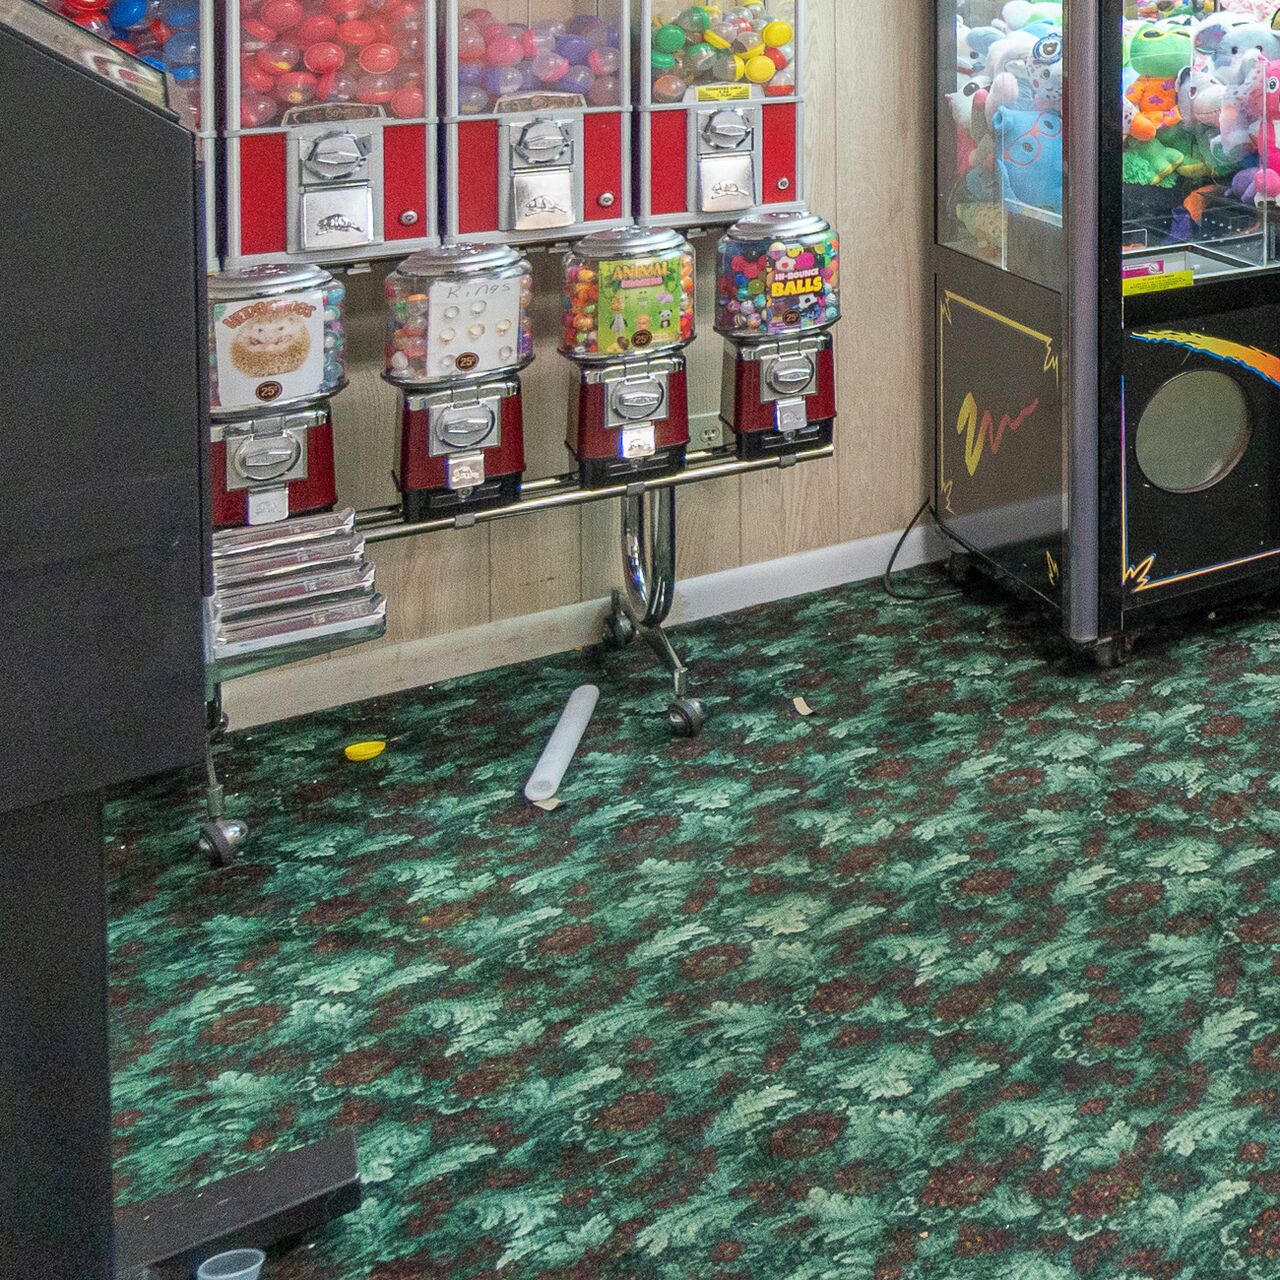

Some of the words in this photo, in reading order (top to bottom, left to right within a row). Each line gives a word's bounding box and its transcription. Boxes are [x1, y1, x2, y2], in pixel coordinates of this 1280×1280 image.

[612, 261, 669, 281] ANIMAL
[447, 282, 511, 299] Rings
[771, 276, 823, 298] BALLS
